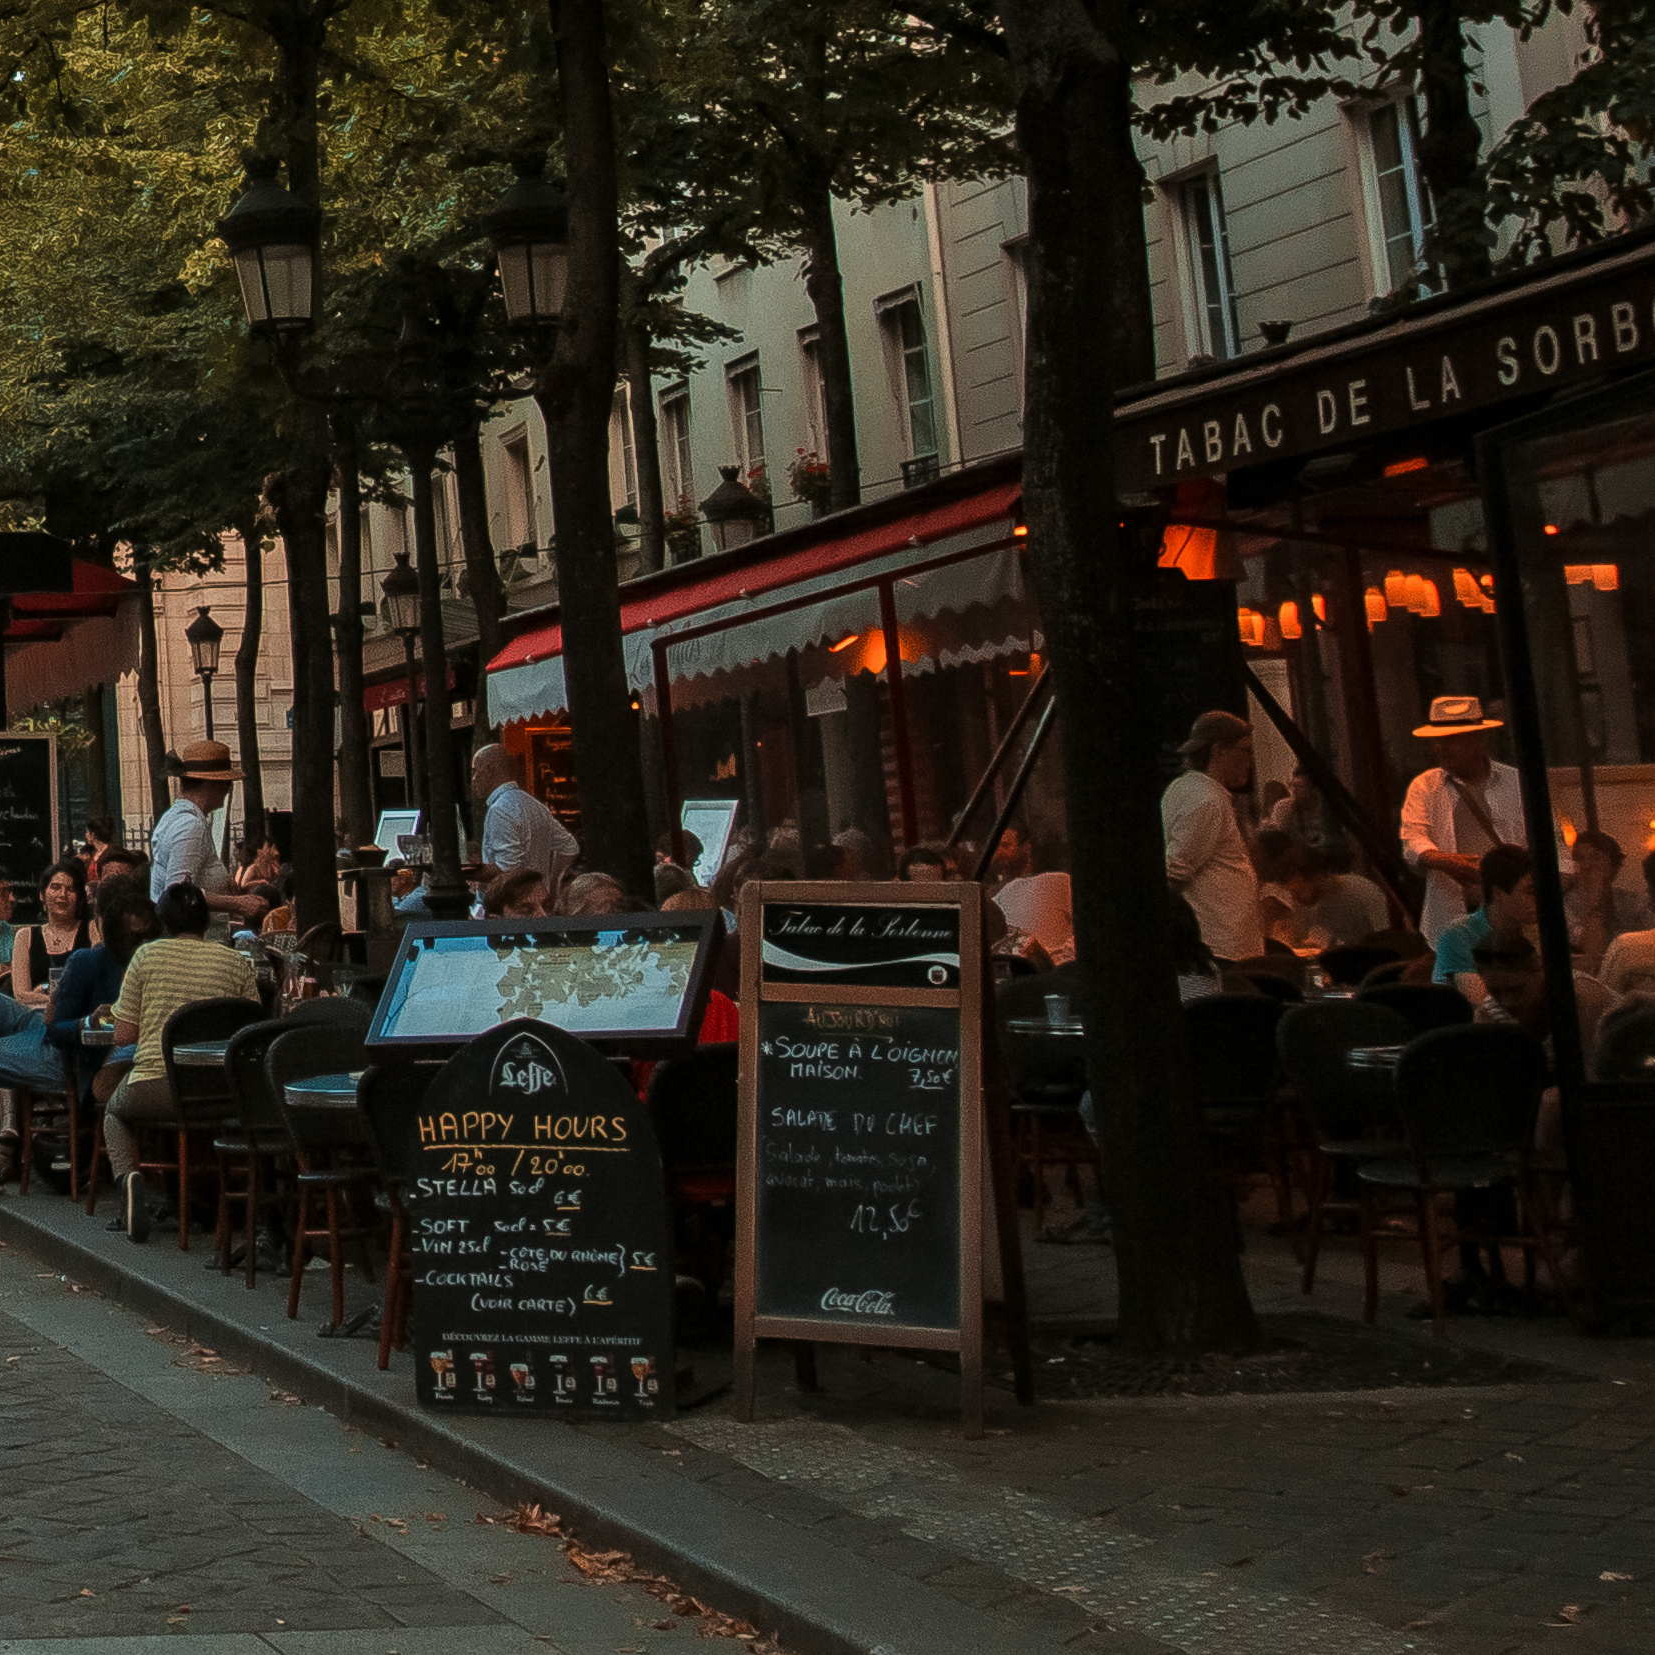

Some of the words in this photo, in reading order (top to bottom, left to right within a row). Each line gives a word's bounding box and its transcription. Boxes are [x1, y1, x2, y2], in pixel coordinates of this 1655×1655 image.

[1149, 404, 1284, 475] TABAC
[1317, 379, 1371, 435] DE
[1405, 355, 1461, 411] LA
[768, 910, 824, 936] Tabac
[826, 916, 846, 936] de
[849, 917, 865, 936] la
[872, 914, 954, 938] Sorbonne
[775, 1035, 840, 1059] SOUPE
[499, 1060, 557, 1095] Leffe
[418, 1111, 514, 1143] HAPPY
[534, 1114, 627, 1142] HOURS
[853, 1112, 875, 1134] DU
[885, 1112, 938, 1135] CHEF
[550, 1249, 567, 1261] DU
[442, 1331, 500, 1342] DÉCOUVREZ
[501, 1333, 513, 1343] LA
[515, 1334, 551, 1343] GAMME
